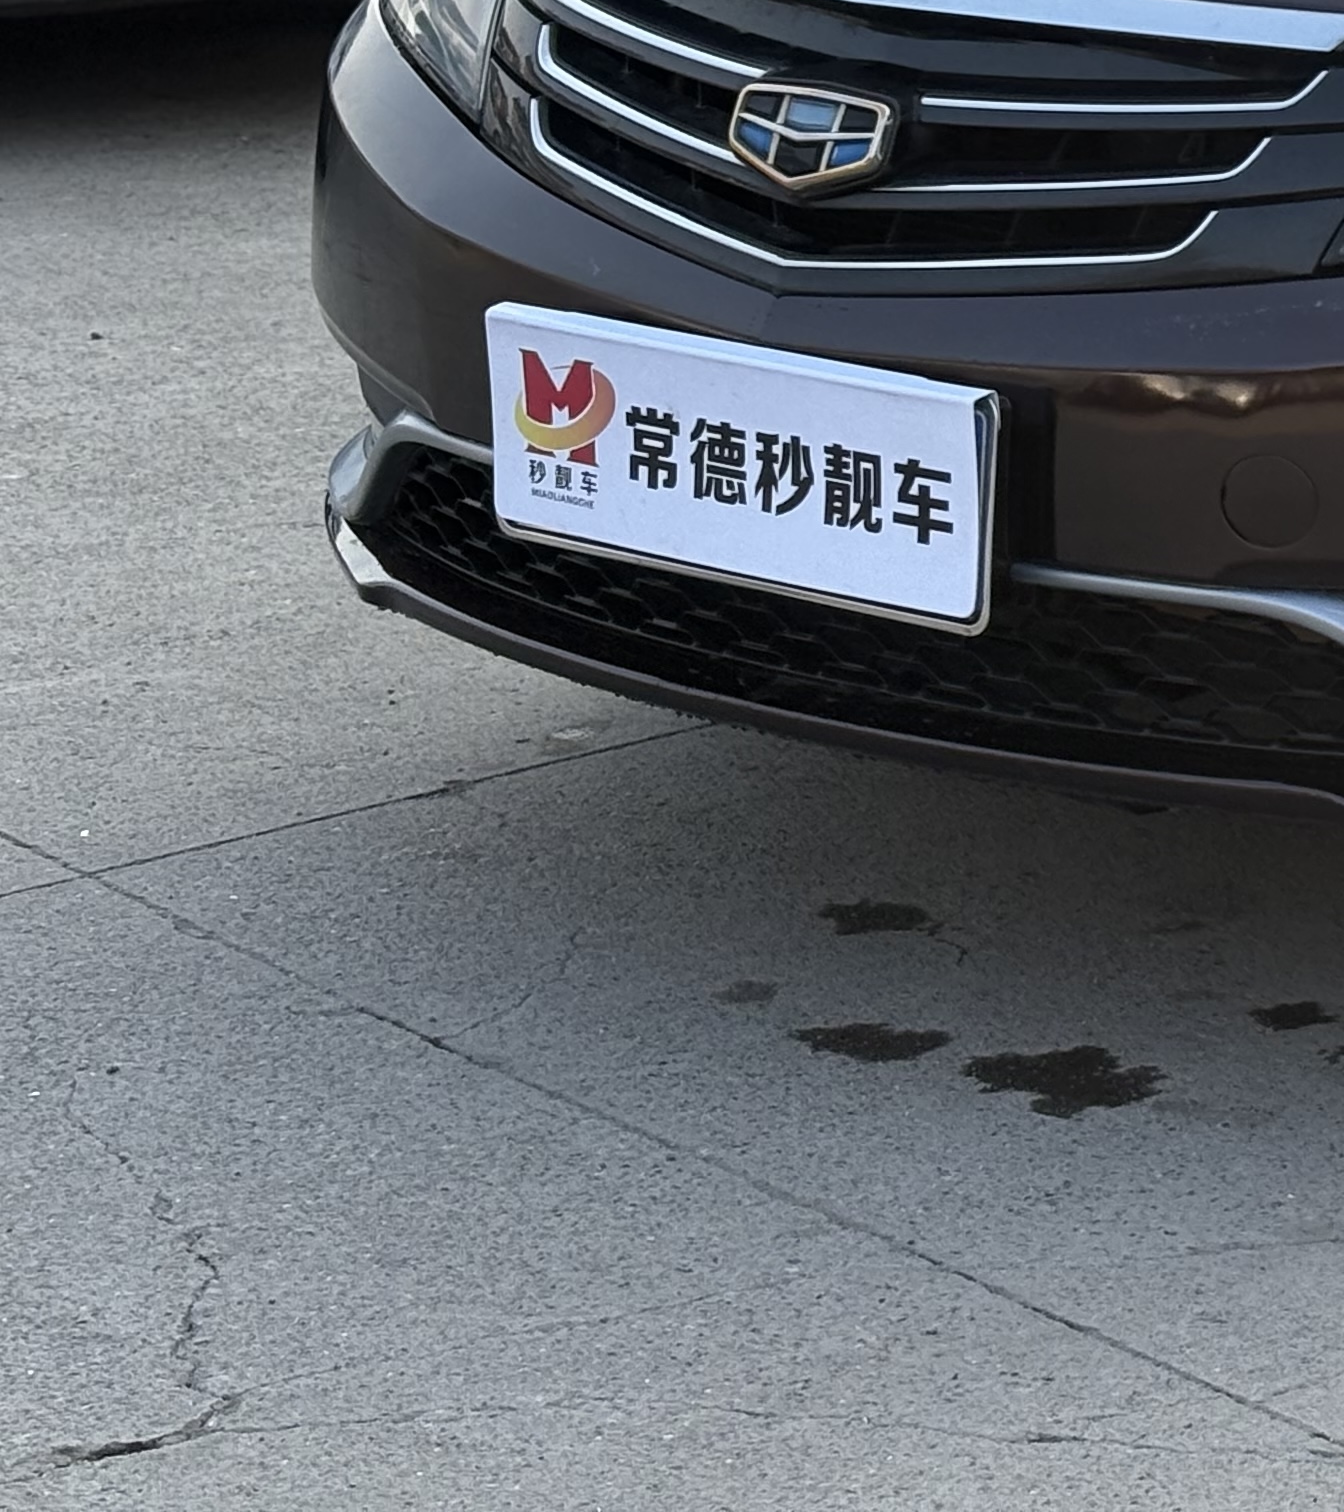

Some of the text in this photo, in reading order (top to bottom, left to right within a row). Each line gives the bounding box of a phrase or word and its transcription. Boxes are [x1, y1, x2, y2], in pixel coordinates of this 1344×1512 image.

[528, 459, 599, 496] 秒靓车
[625, 405, 955, 546] 常德秒靓车
